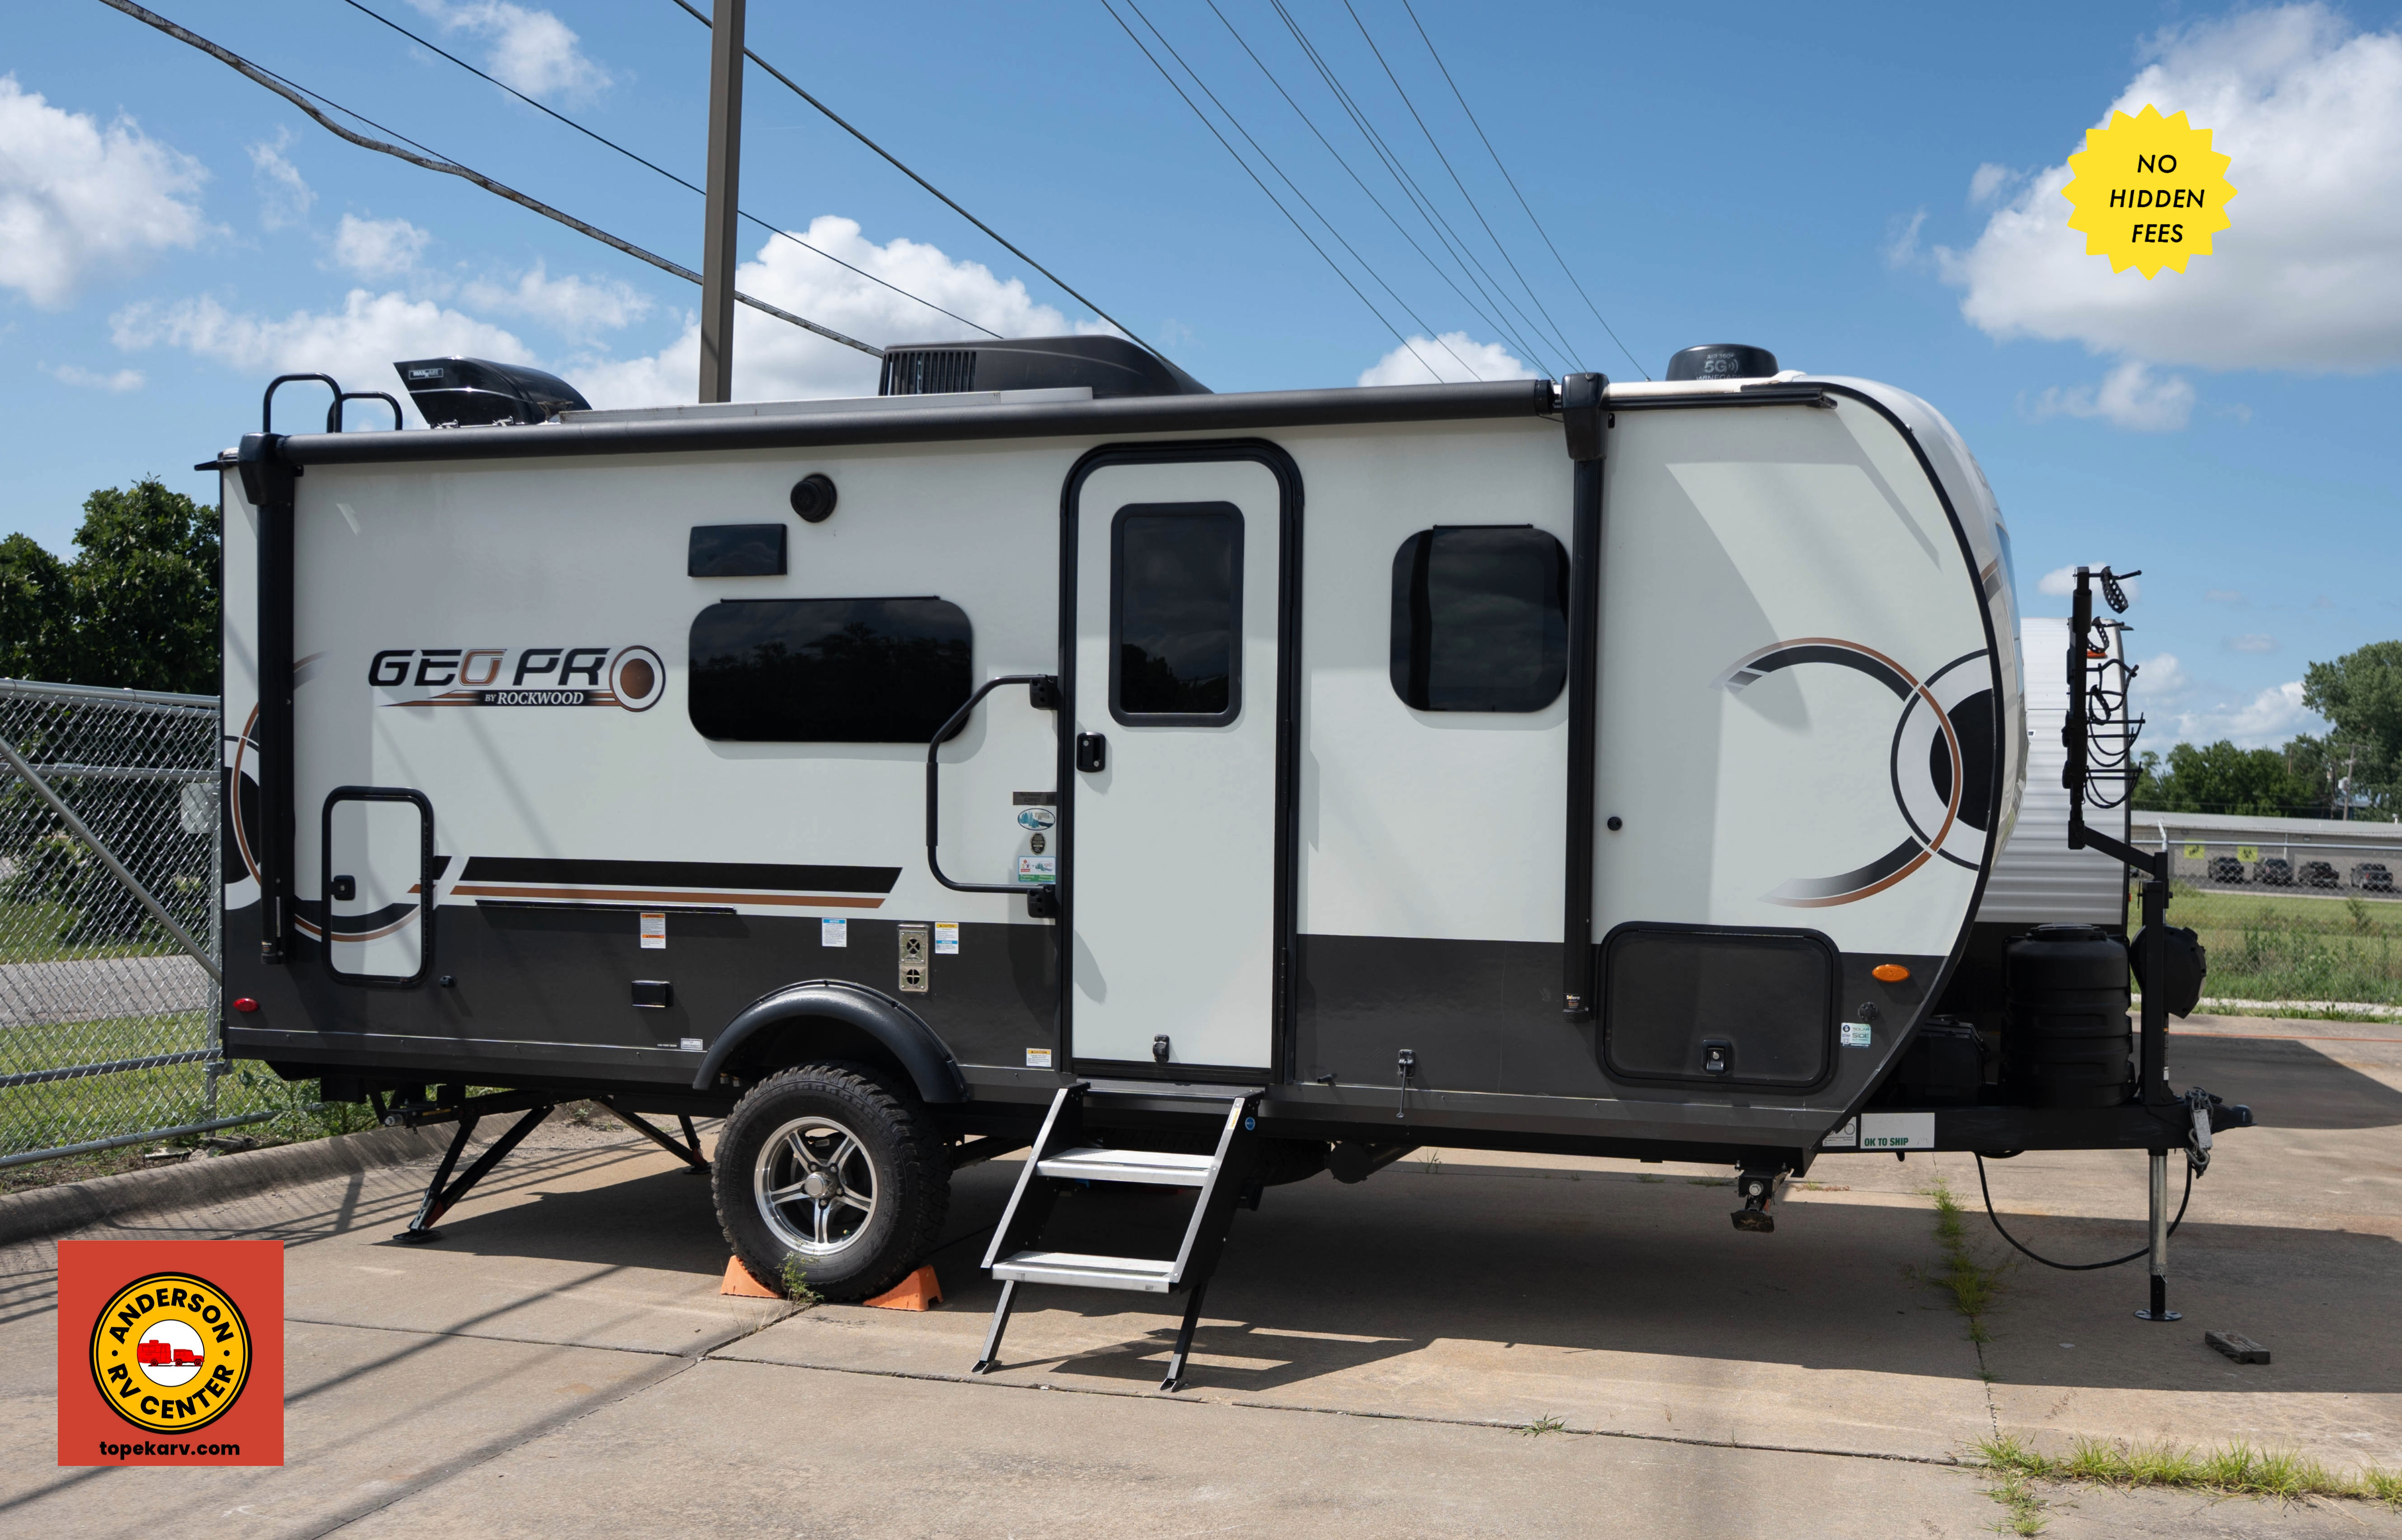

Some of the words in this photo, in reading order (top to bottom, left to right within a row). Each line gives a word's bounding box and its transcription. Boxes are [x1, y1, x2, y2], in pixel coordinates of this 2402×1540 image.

[1704, 361, 1727, 373] 5G
[368, 649, 508, 686] GEO
[485, 694, 496, 702] BY
[496, 691, 584, 705] ROCKWOOD
[1864, 1138, 1875, 1146] OK
[1890, 1137, 1909, 1146] SHIP
